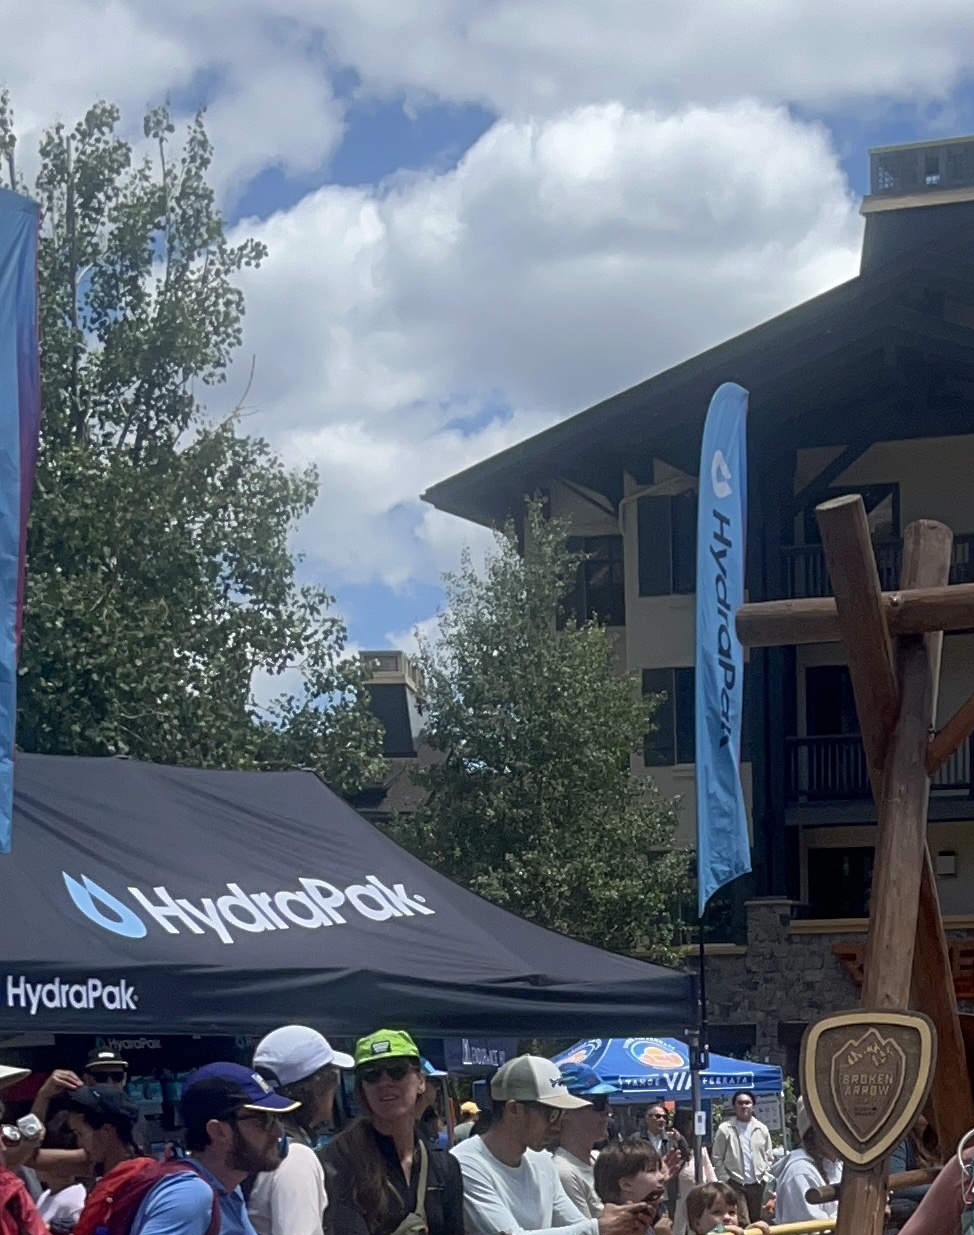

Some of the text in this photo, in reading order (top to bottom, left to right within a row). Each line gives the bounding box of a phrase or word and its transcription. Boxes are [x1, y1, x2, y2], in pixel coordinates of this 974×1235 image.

[709, 508, 737, 750] HydraPak
[127, 875, 436, 944] HydraPak
[6, 975, 138, 1015] HydraPak
[842, 1073, 894, 1084] BROKEN
[844, 1085, 890, 1096] ARROW
